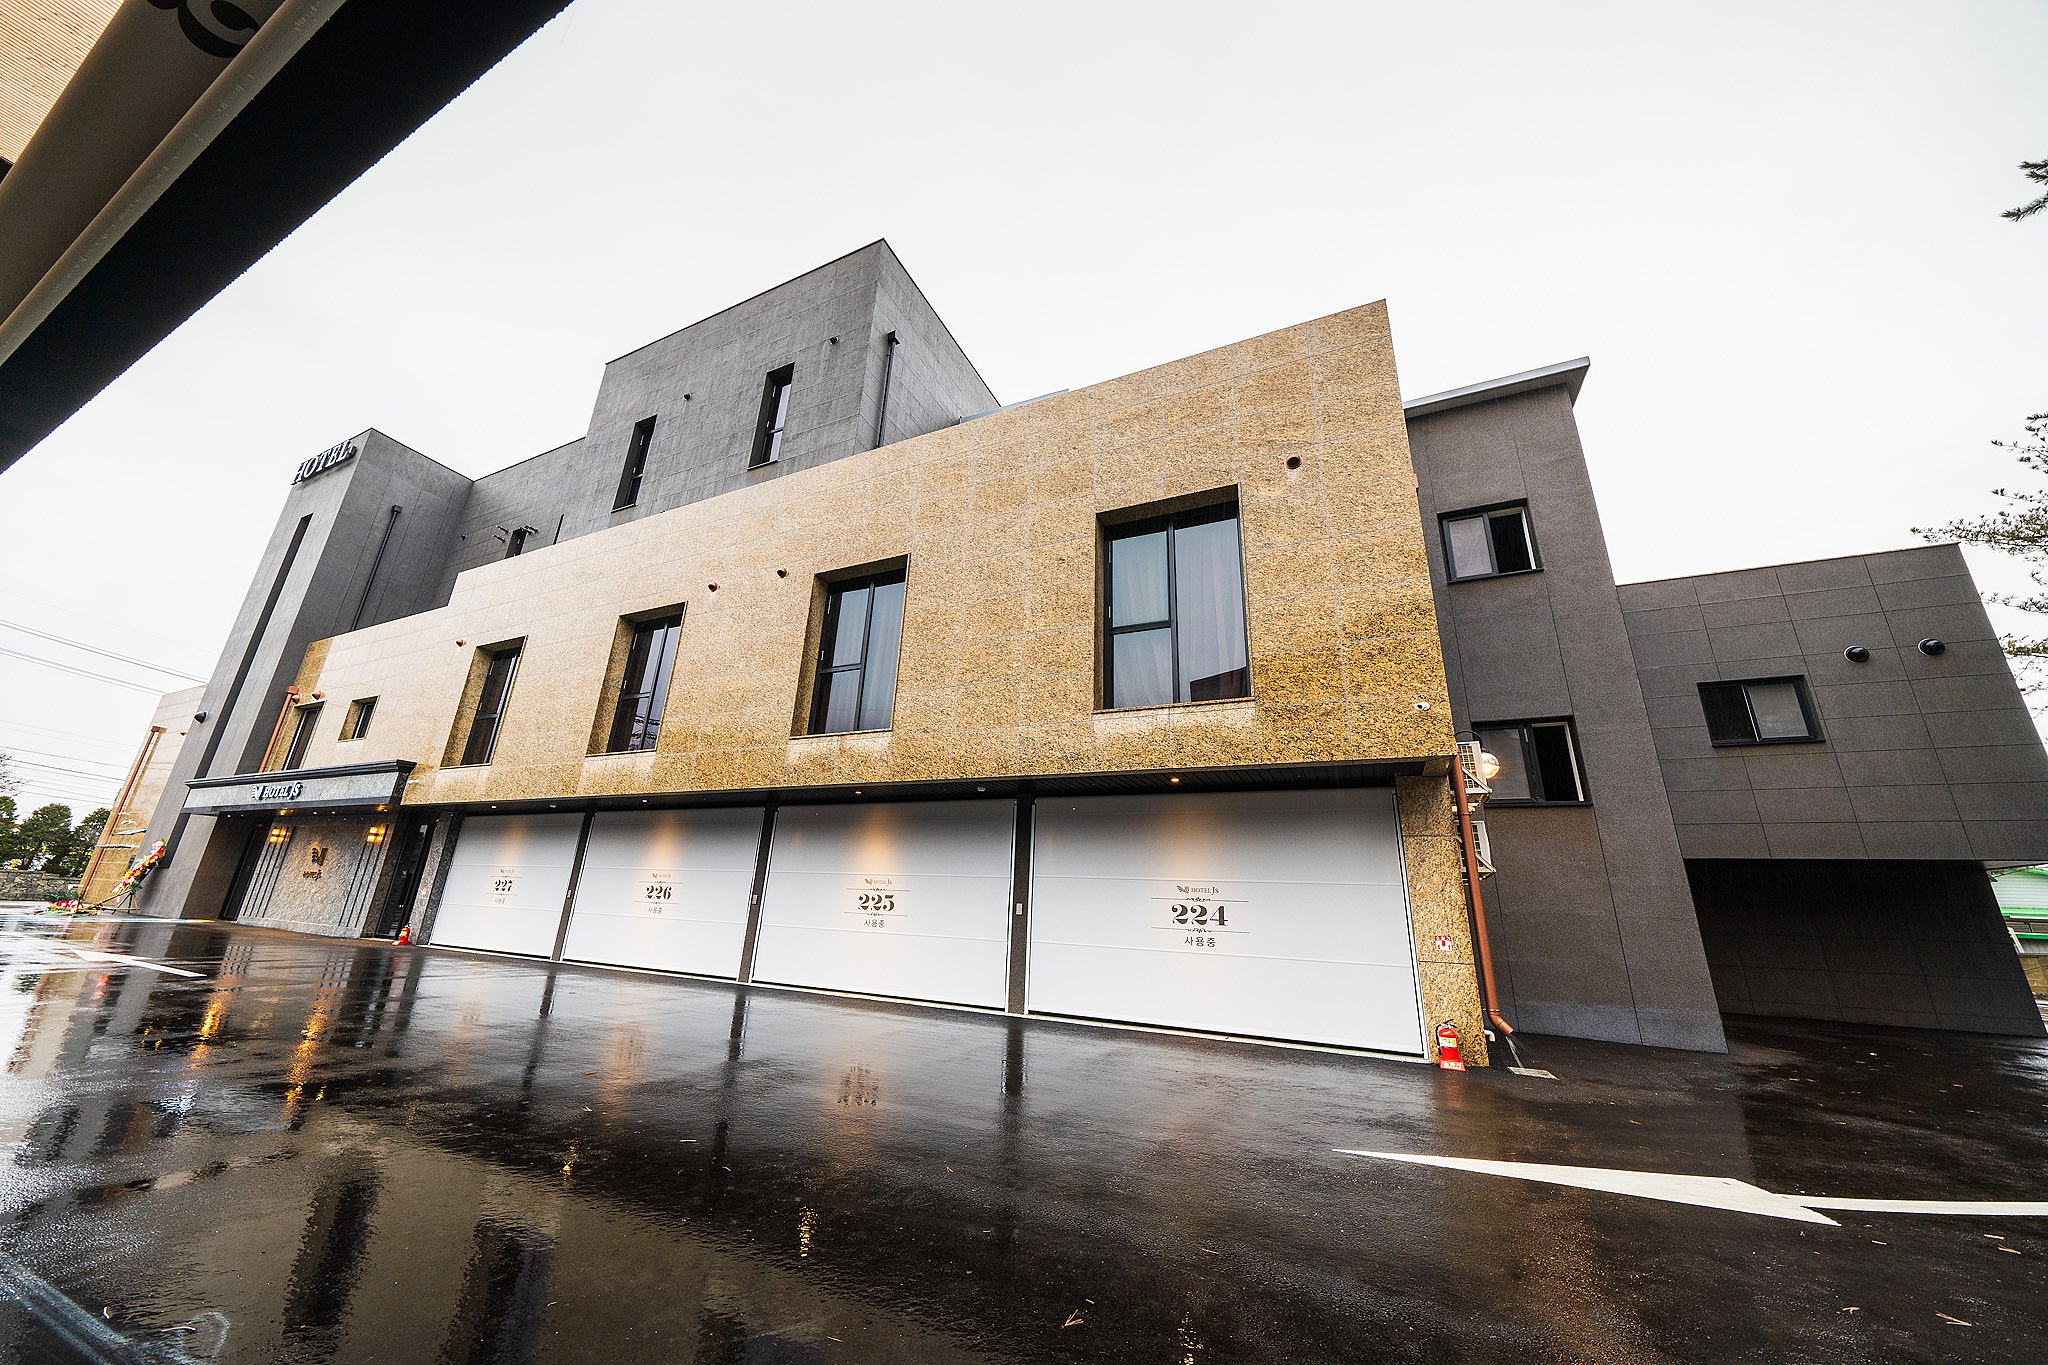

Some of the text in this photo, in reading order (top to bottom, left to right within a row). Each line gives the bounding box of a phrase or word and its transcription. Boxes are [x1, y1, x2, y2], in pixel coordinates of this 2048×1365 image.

[262, 785, 290, 798] HOTEL
[493, 879, 514, 892] 227
[1191, 886, 1211, 894] HOTEL
[645, 885, 672, 900] 226
[858, 893, 895, 912] 225
[1171, 903, 1229, 927] 224
[1184, 936, 1216, 948] 사용중
